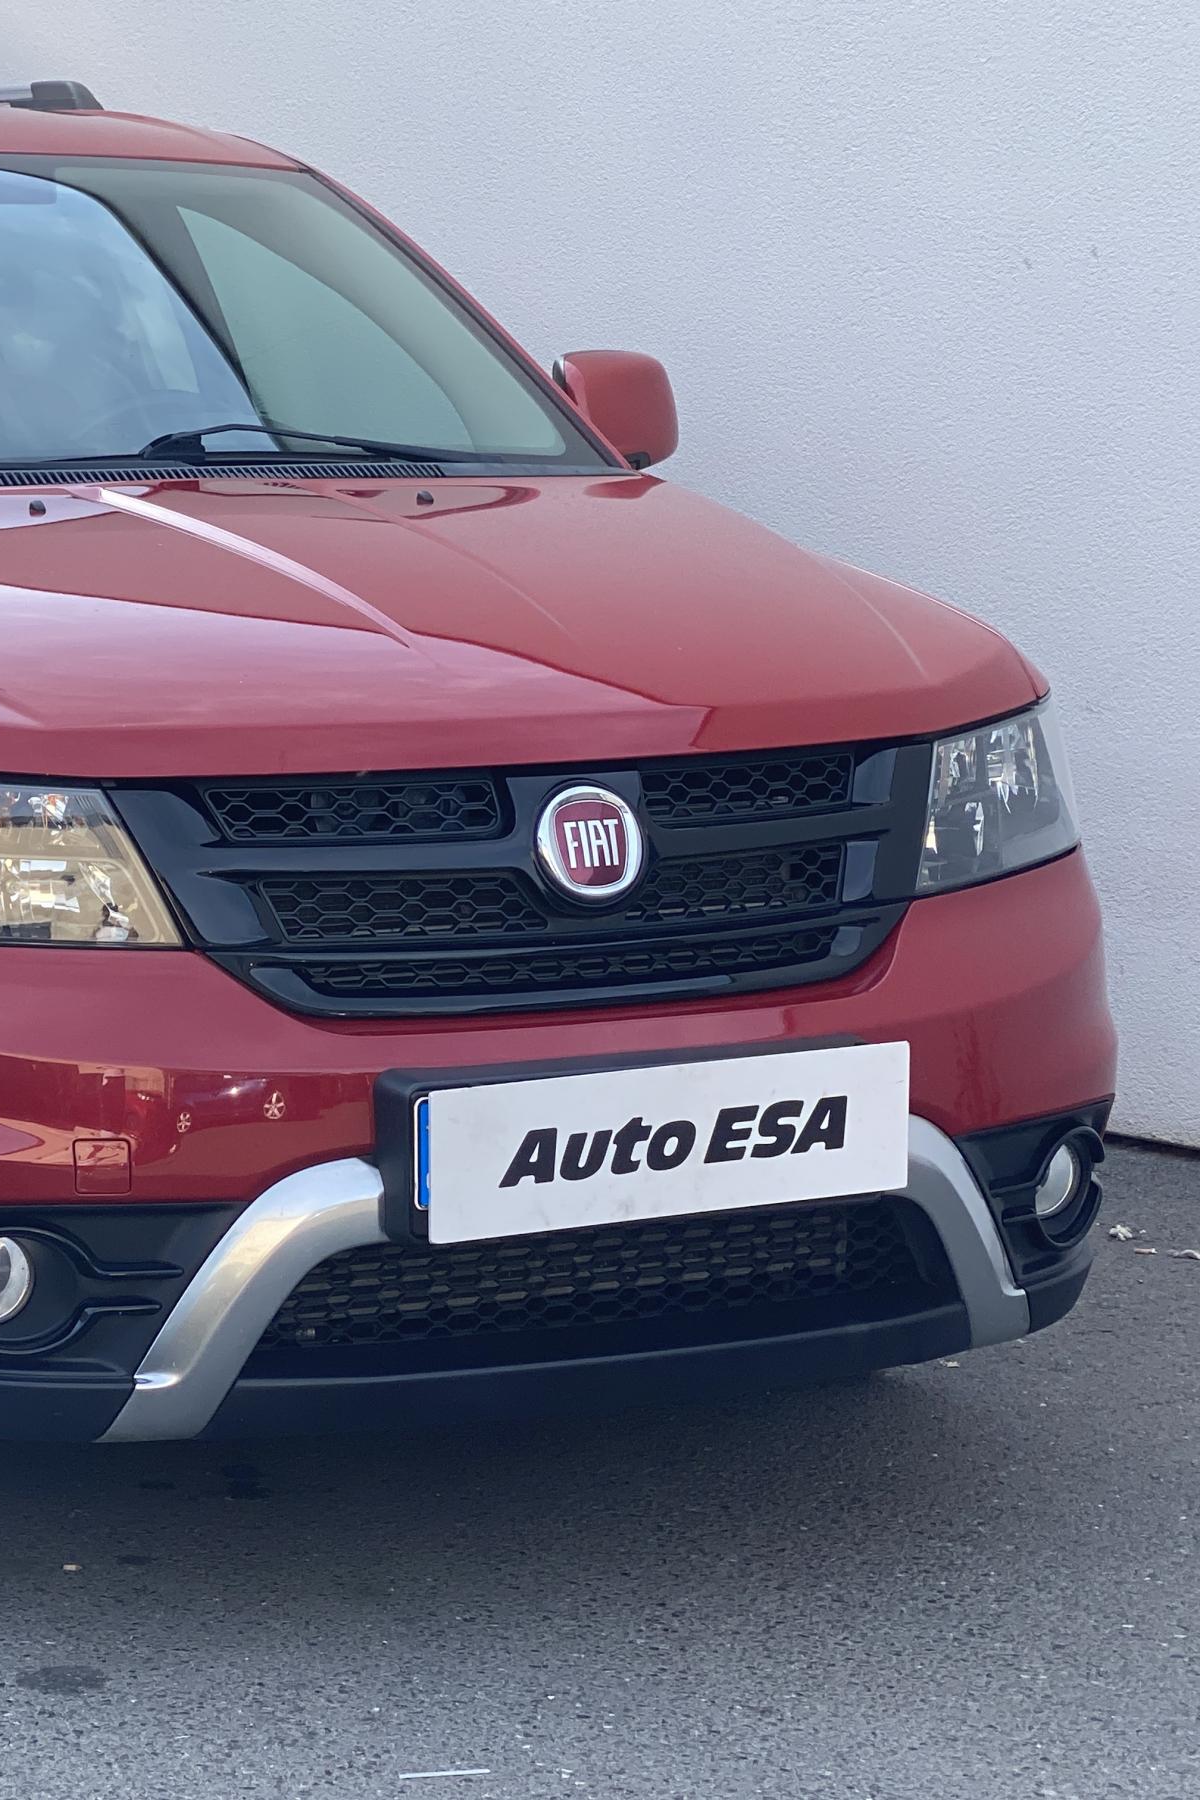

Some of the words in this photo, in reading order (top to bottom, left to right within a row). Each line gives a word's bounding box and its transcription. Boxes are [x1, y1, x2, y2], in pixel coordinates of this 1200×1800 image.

[563, 819, 620, 869] FIAT
[499, 1117, 696, 1188] Auto
[704, 1096, 847, 1163] ESA
